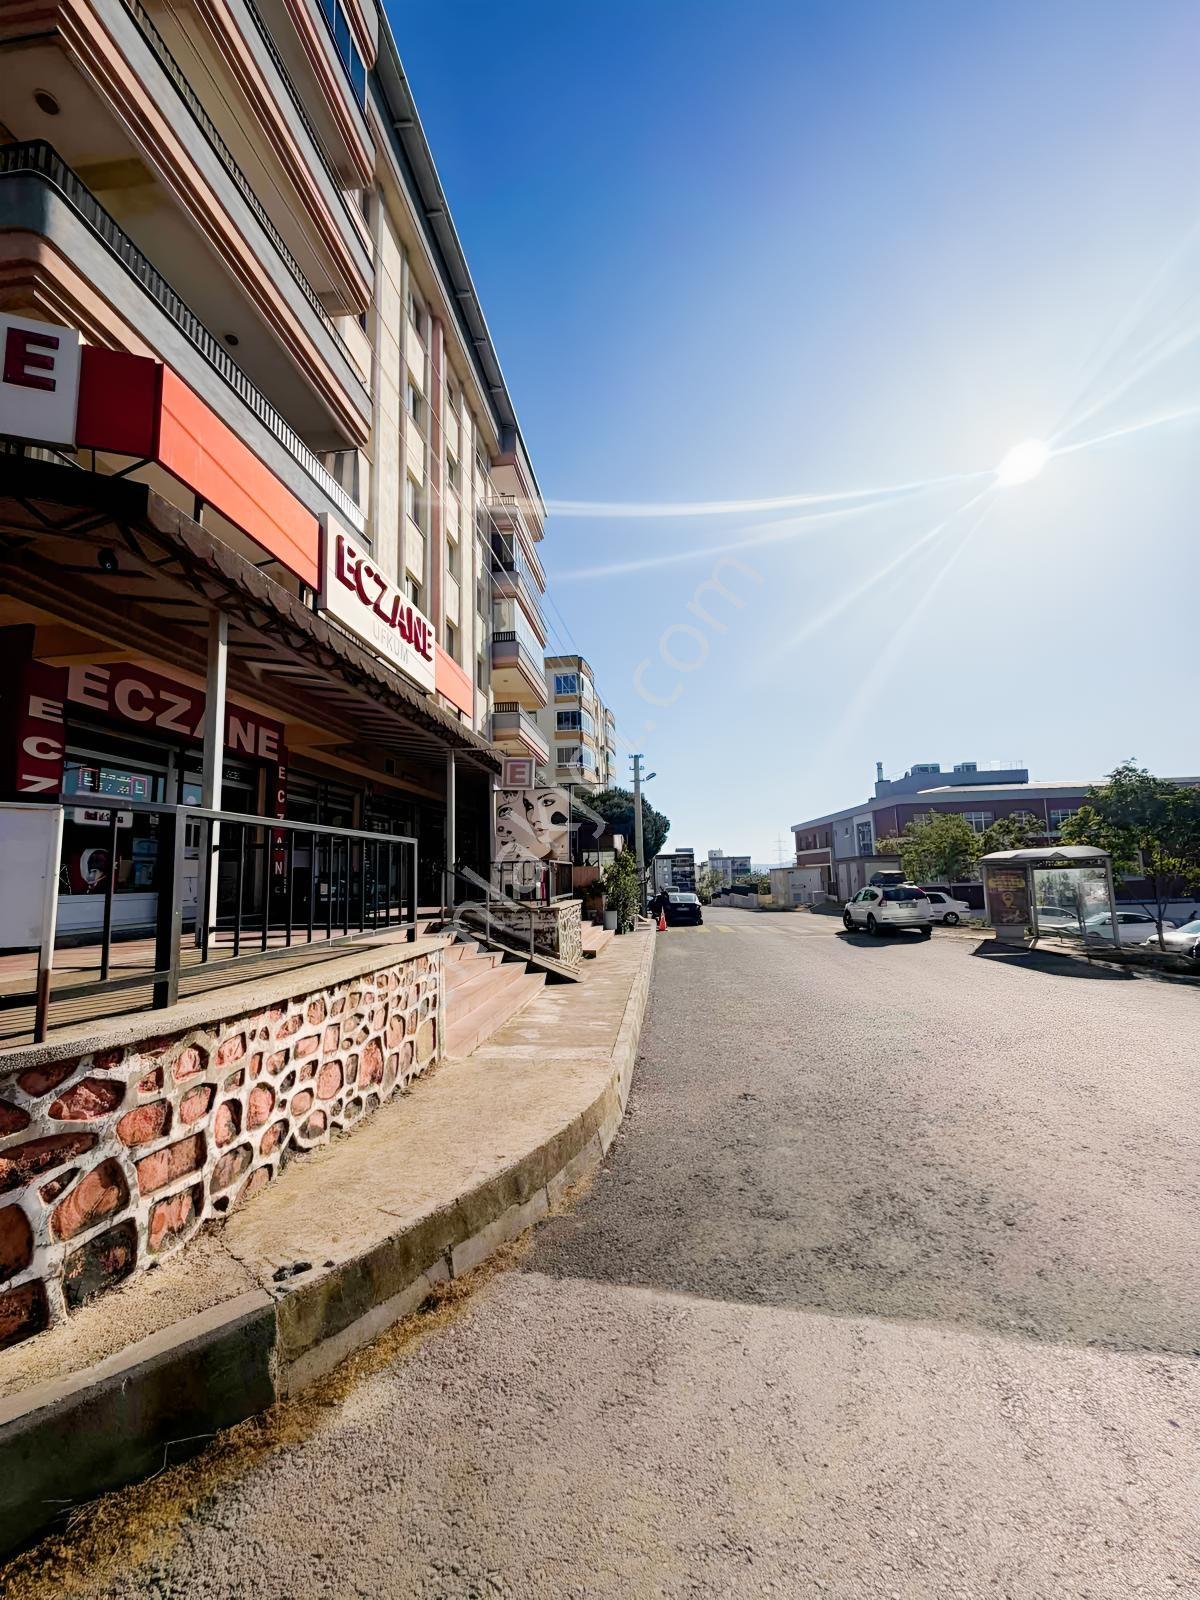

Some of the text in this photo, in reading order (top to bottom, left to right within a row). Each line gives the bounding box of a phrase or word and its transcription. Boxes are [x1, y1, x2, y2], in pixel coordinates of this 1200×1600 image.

[3, 327, 60, 392] E
[335, 534, 433, 662] ECZANE
[66, 662, 279, 761] ECZNE
[508, 763, 527, 784] E
